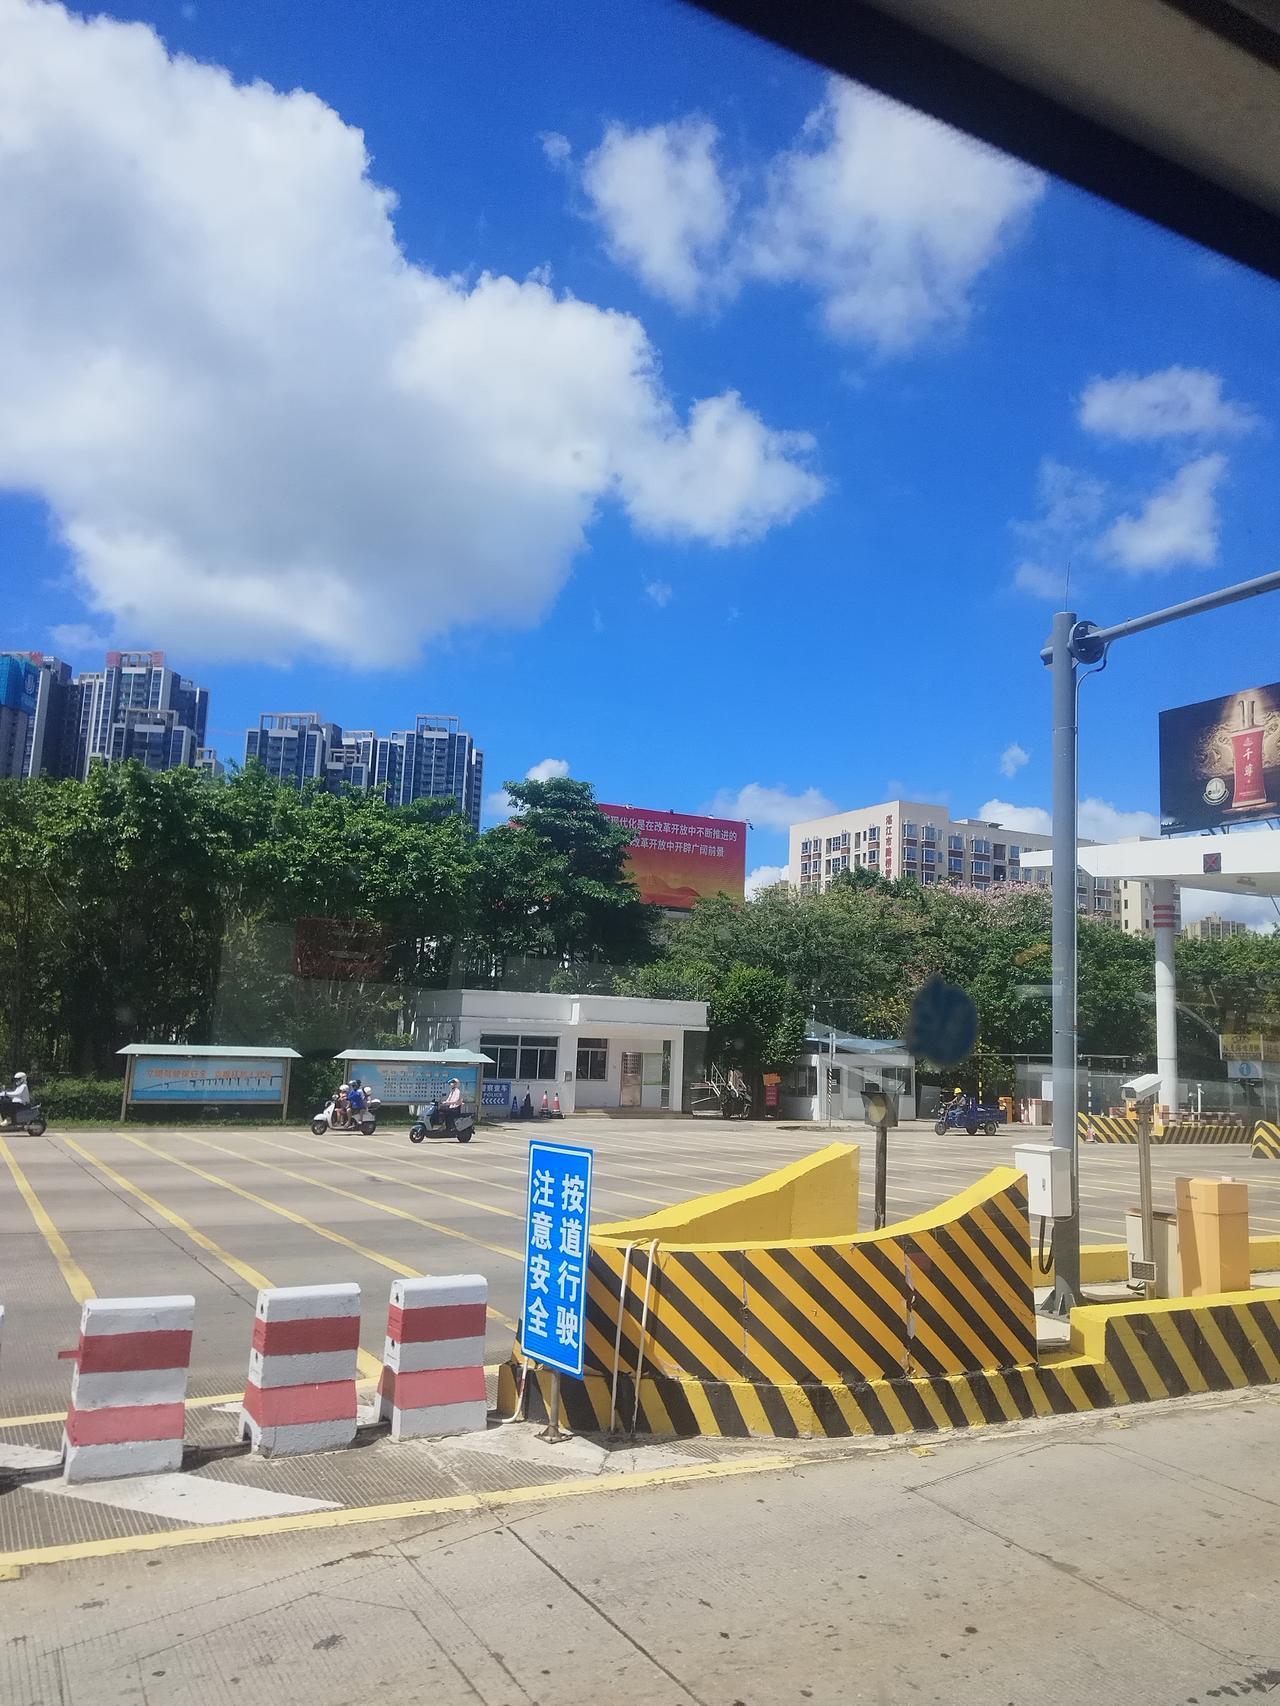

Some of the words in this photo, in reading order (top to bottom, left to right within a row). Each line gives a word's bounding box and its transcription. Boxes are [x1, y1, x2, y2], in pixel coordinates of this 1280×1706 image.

[528, 1169, 555, 1338] 注意安全
[556, 1173, 585, 1349] 按道行驶
